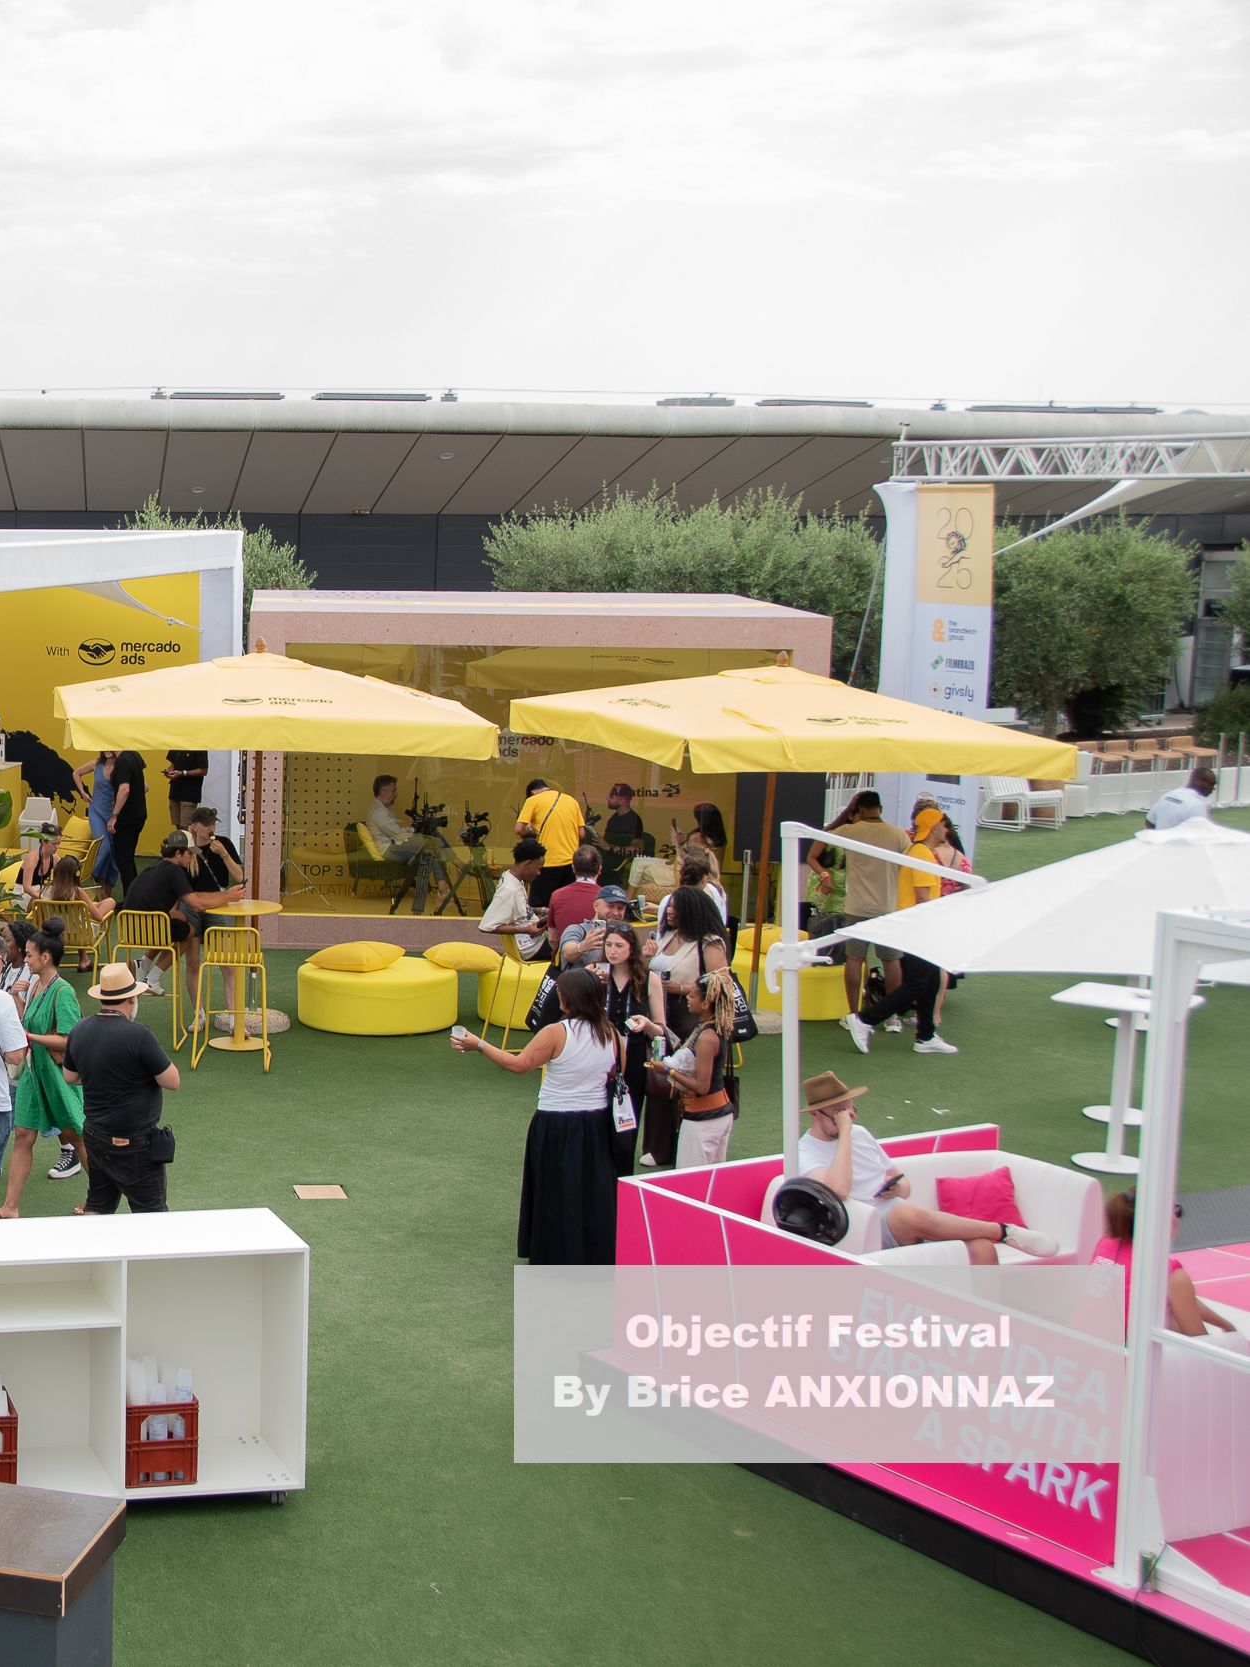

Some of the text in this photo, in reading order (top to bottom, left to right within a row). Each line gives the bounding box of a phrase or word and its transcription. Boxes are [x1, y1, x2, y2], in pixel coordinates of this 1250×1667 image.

[936, 507, 974, 541] 20
[936, 555, 972, 590] 25
[948, 627, 977, 635] brandtech
[948, 634, 964, 642] group
[46, 641, 181, 656] With mercado
[120, 653, 146, 665] ads
[945, 658, 975, 671] FILMBRAZIL
[944, 683, 974, 703] givsly
[499, 746, 519, 758] ds
[610, 787, 659, 797] Adlatina
[936, 795, 966, 806] mercado
[301, 864, 331, 877] TOP
[335, 865, 344, 877] 3
[998, 1338, 1108, 1416] IDEA
[988, 1382, 1110, 1467] WITH
[913, 1410, 1110, 1520] A SPARK
